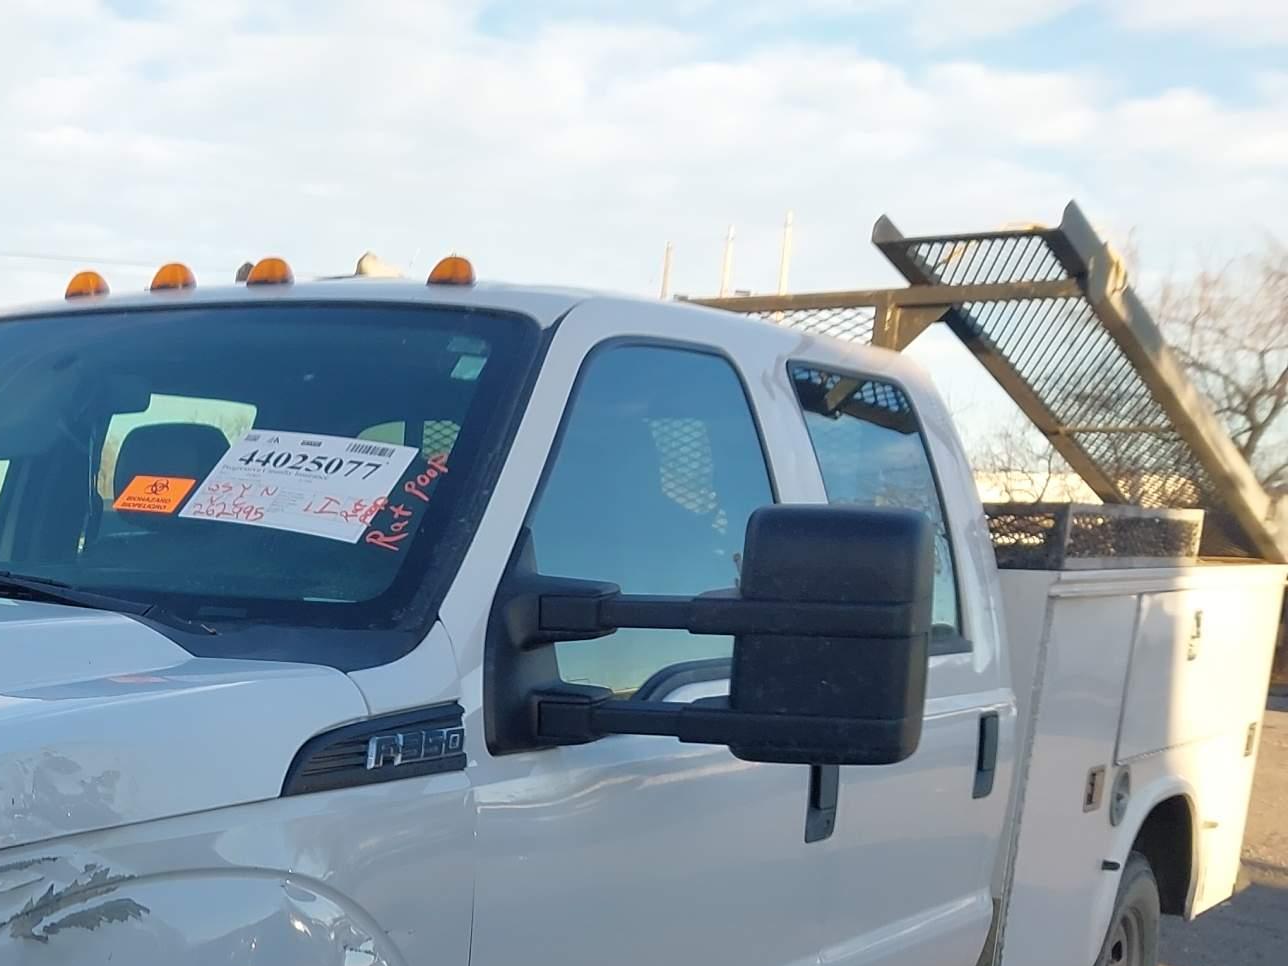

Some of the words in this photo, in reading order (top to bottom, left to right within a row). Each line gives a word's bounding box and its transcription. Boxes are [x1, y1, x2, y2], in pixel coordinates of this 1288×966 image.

[238, 449, 383, 481] 44025077
[126, 495, 172, 504] BIOHAZARD
[365, 503, 413, 552] Rat
